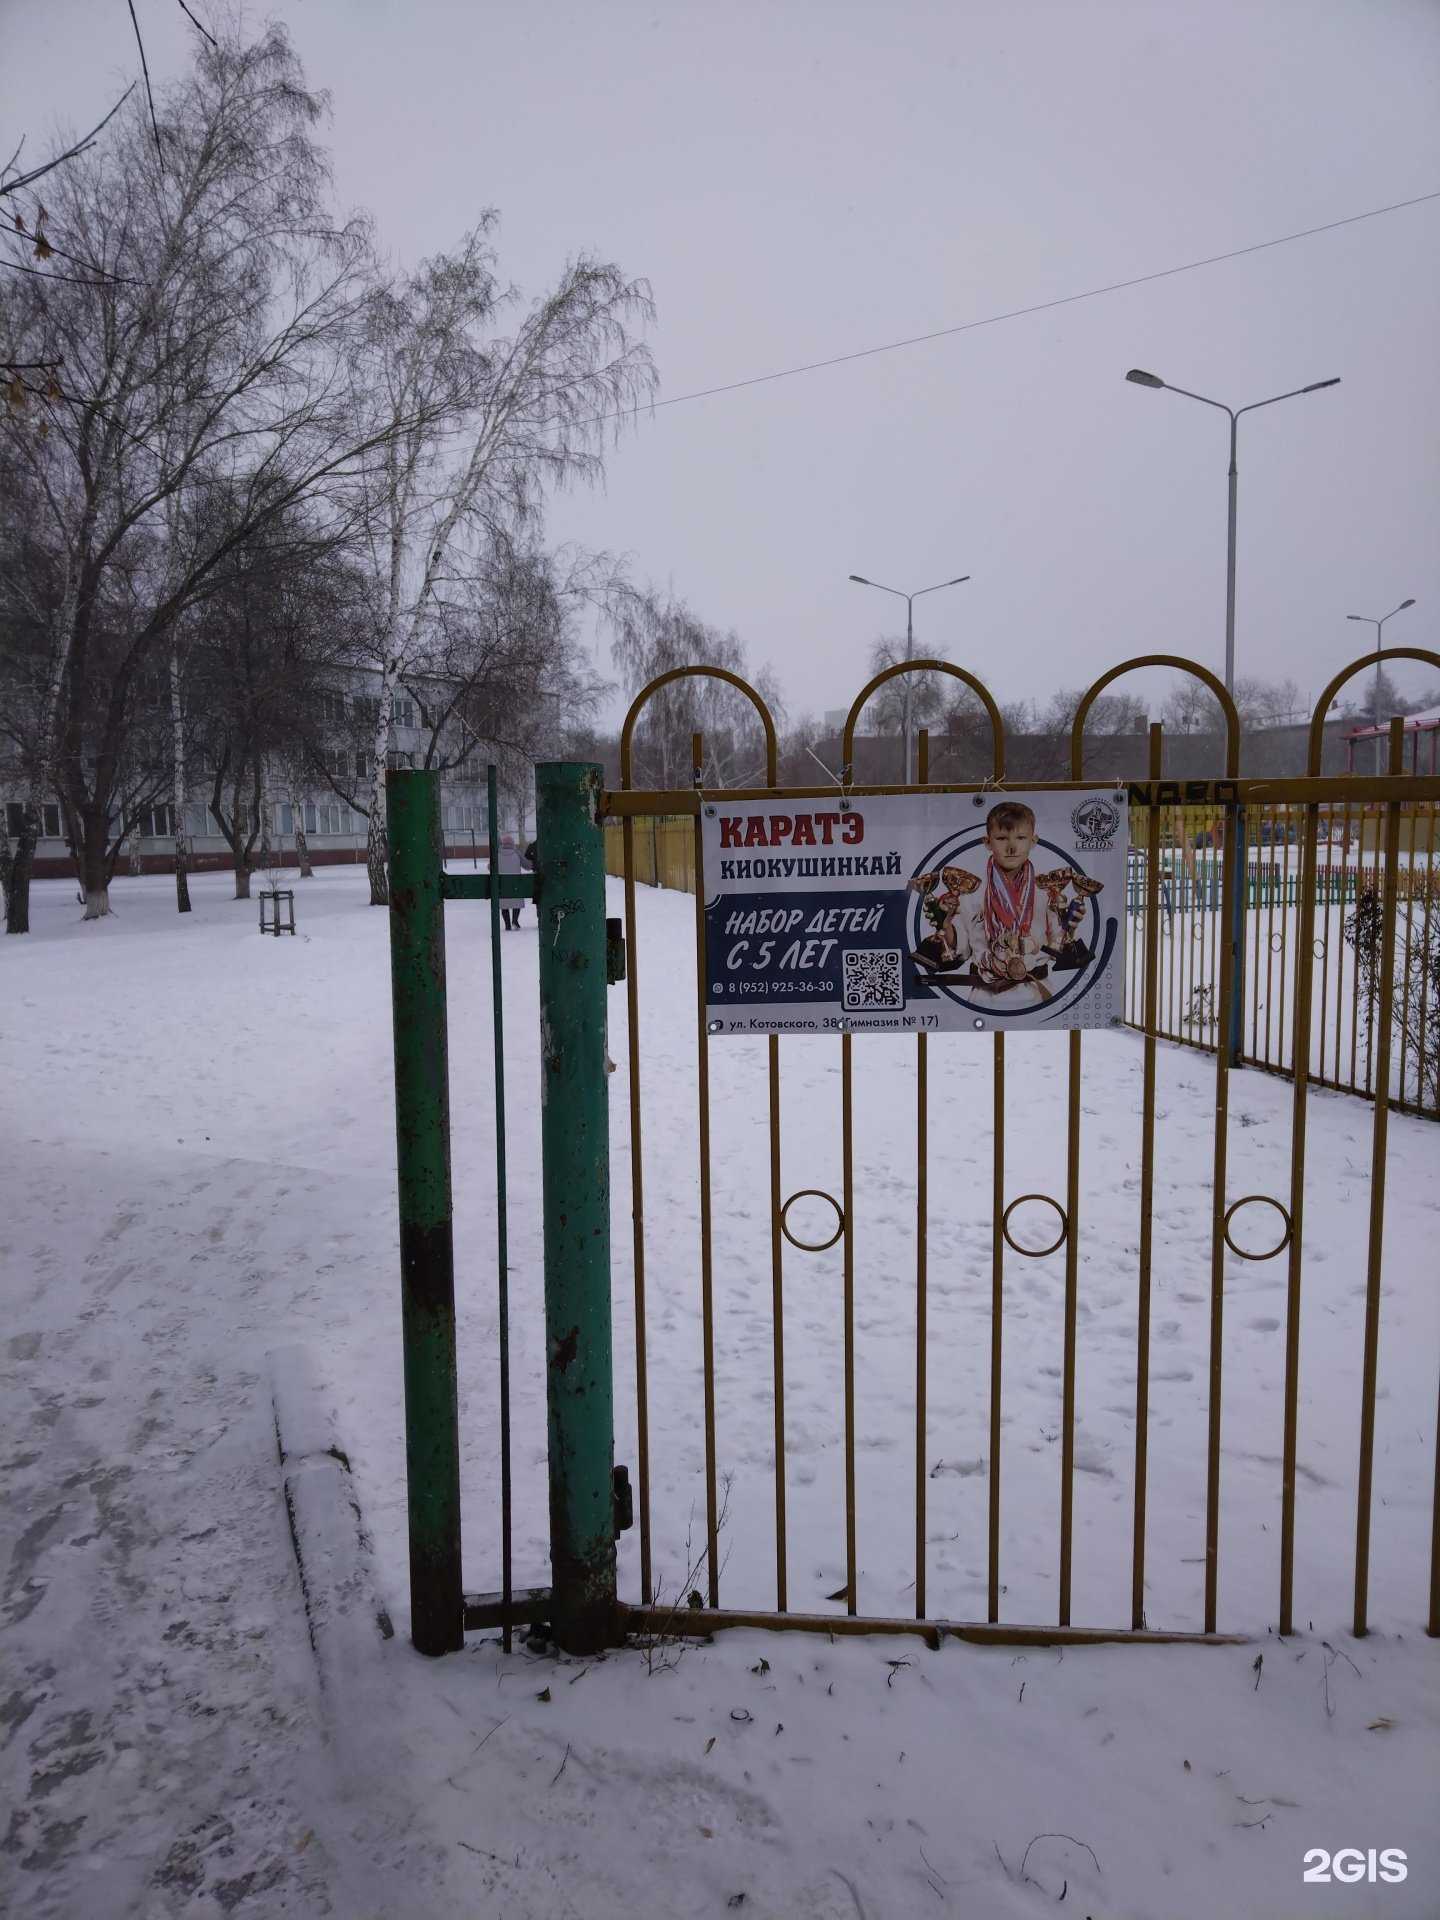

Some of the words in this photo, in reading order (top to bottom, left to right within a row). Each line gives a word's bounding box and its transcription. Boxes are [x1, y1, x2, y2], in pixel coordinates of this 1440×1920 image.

[719, 812, 865, 848] КАРАТЭ
[1074, 840, 1114, 849] LEGION
[720, 851, 902, 880] КИОКУШИНКАЙ
[724, 908, 804, 935] НАБОР
[804, 903, 885, 934] ДЕТЕЙ
[726, 939, 749, 970] С
[752, 940, 776, 970] 5
[779, 938, 839, 970] ЛЕТ
[728, 982, 736, 993] 8
[739, 980, 769, 995] (952)
[771, 980, 834, 993] 925-36-30
[729, 1019, 745, 1030] ул.
[749, 1018, 819, 1030] Котовского,
[822, 1017, 837, 1028] 38
[902, 1016, 917, 1027] №
[920, 1015, 939, 1028] 17)
